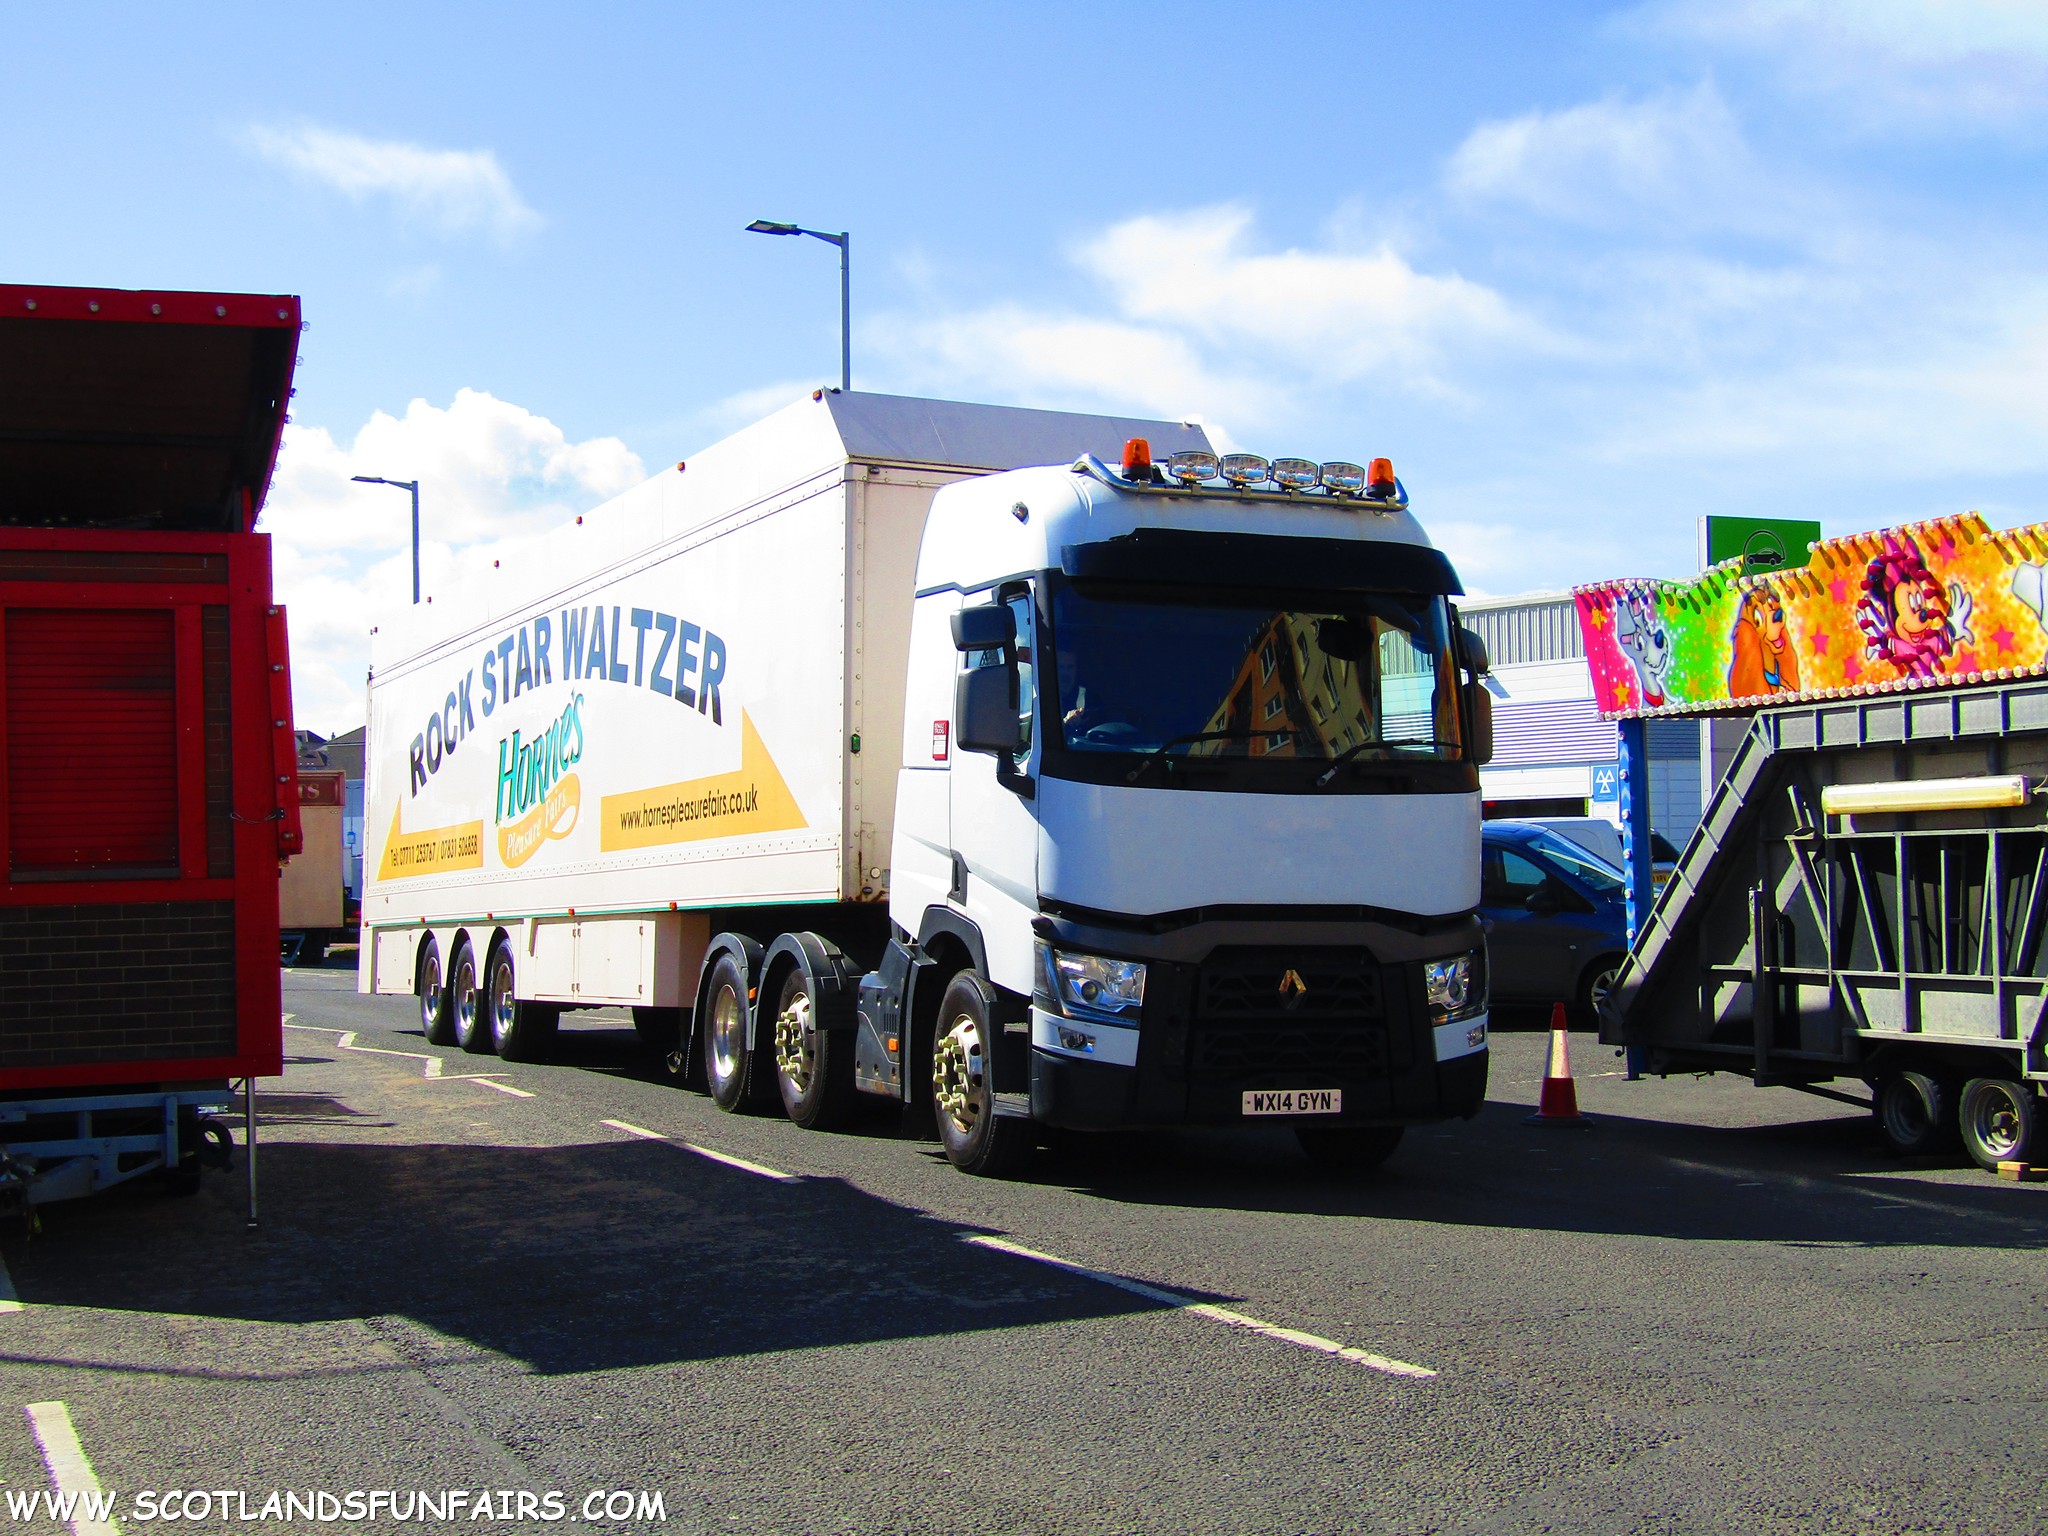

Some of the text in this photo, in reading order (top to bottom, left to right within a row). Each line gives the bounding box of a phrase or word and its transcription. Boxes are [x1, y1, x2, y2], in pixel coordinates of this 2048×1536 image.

[409, 605, 727, 799] ROCK STAR WALTZER
[620, 783, 758, 830] www.hornespleasurefairs.co.uk
[1253, 1092, 1331, 1112] WX14 GYN
